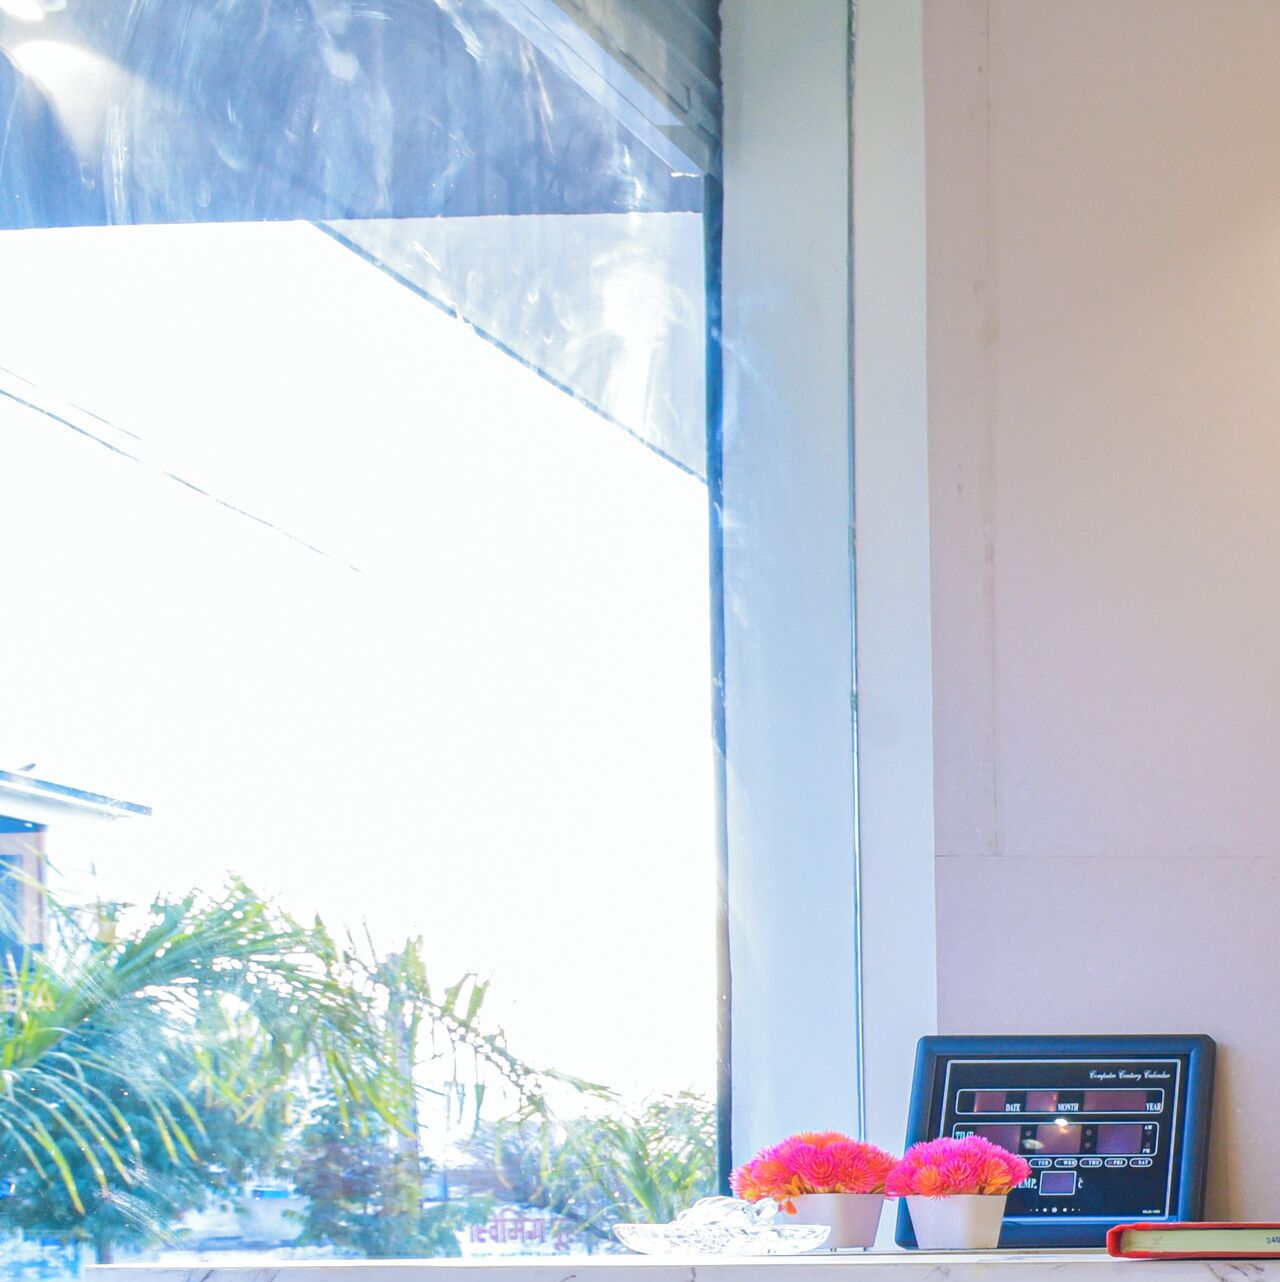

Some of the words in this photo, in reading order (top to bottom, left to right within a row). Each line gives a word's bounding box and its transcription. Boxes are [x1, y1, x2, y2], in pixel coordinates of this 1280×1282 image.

[1118, 1070, 1142, 1081] Century
[1005, 1103, 1021, 1112] DATE
[1057, 1103, 1079, 1112] MONTH
[1146, 1102, 1161, 1111] YEAR
